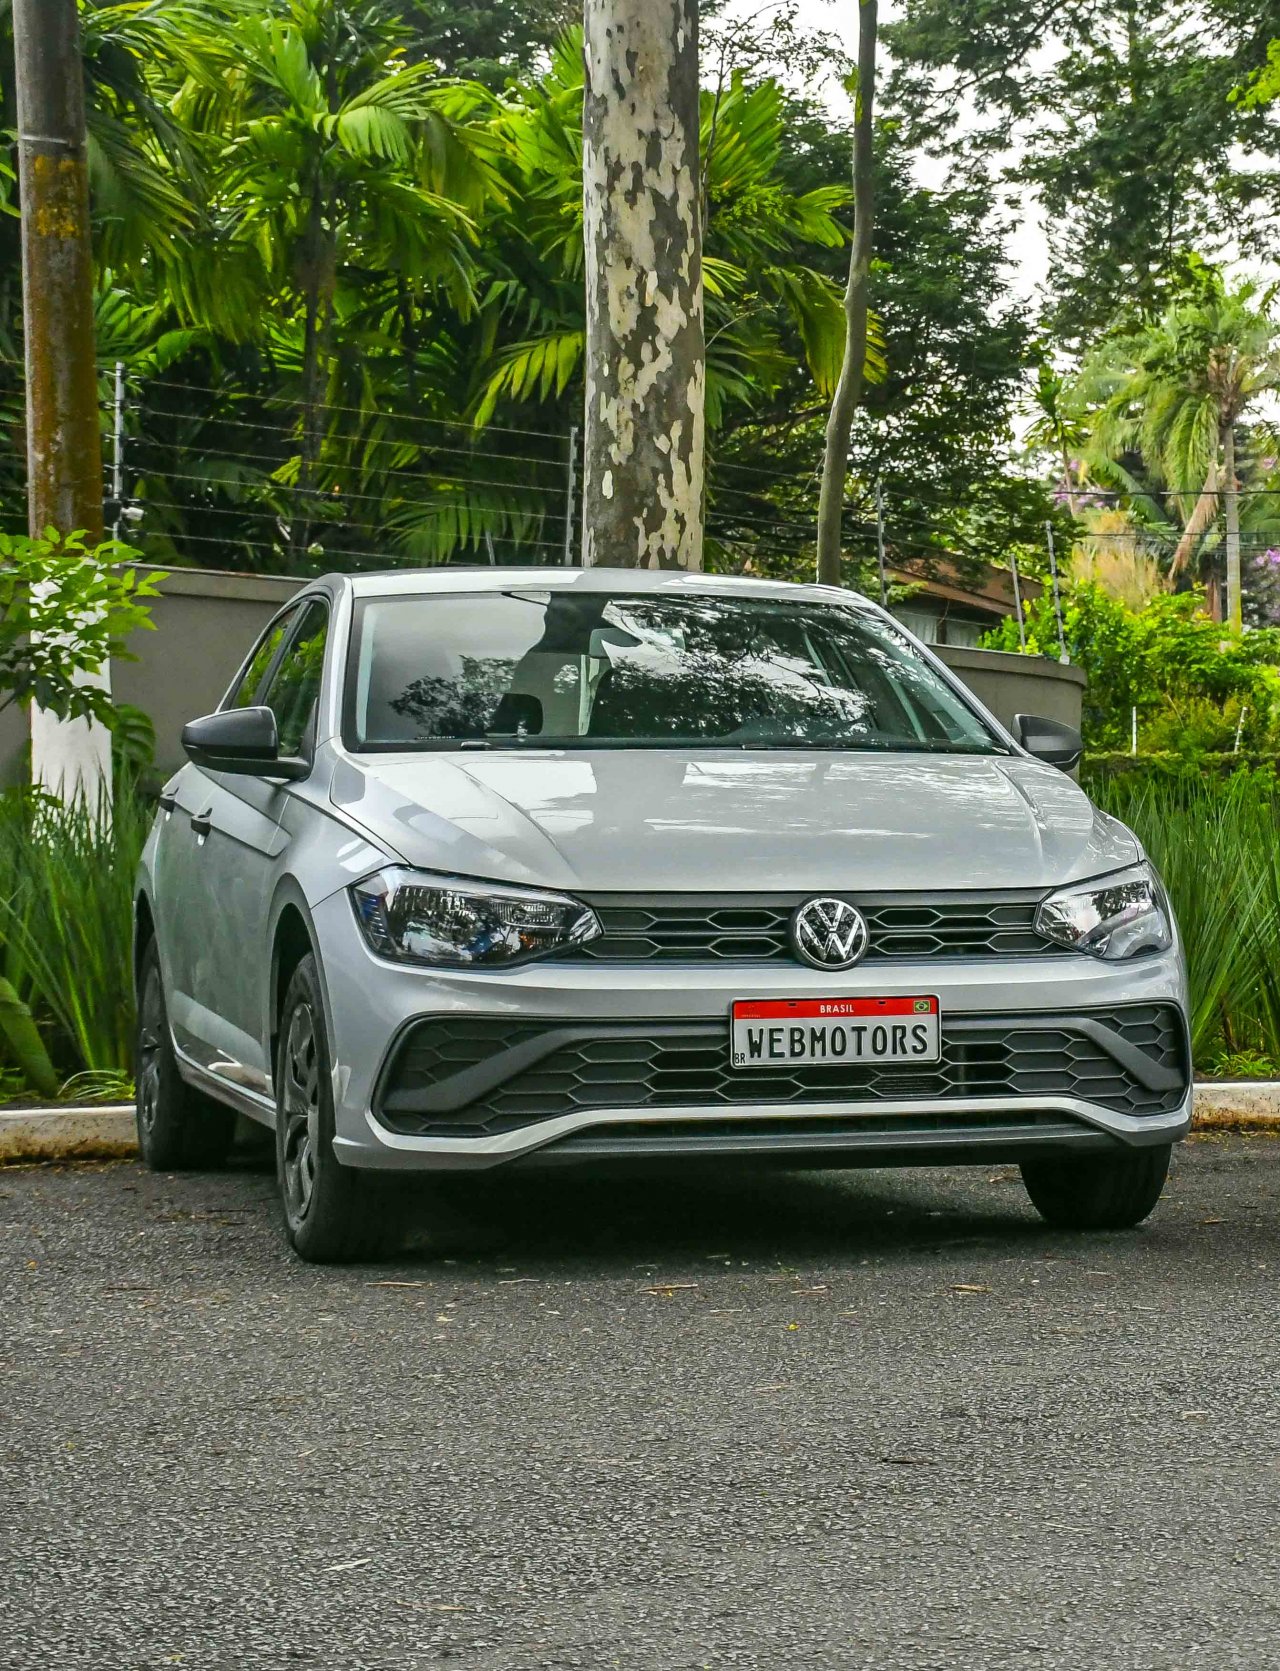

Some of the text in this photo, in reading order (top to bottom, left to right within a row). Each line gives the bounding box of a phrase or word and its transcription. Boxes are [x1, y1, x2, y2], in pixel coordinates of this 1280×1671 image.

[820, 1004, 855, 1014] BRASIL
[747, 1024, 928, 1059] WEBMOTORS
[734, 1052, 746, 1065] BR
